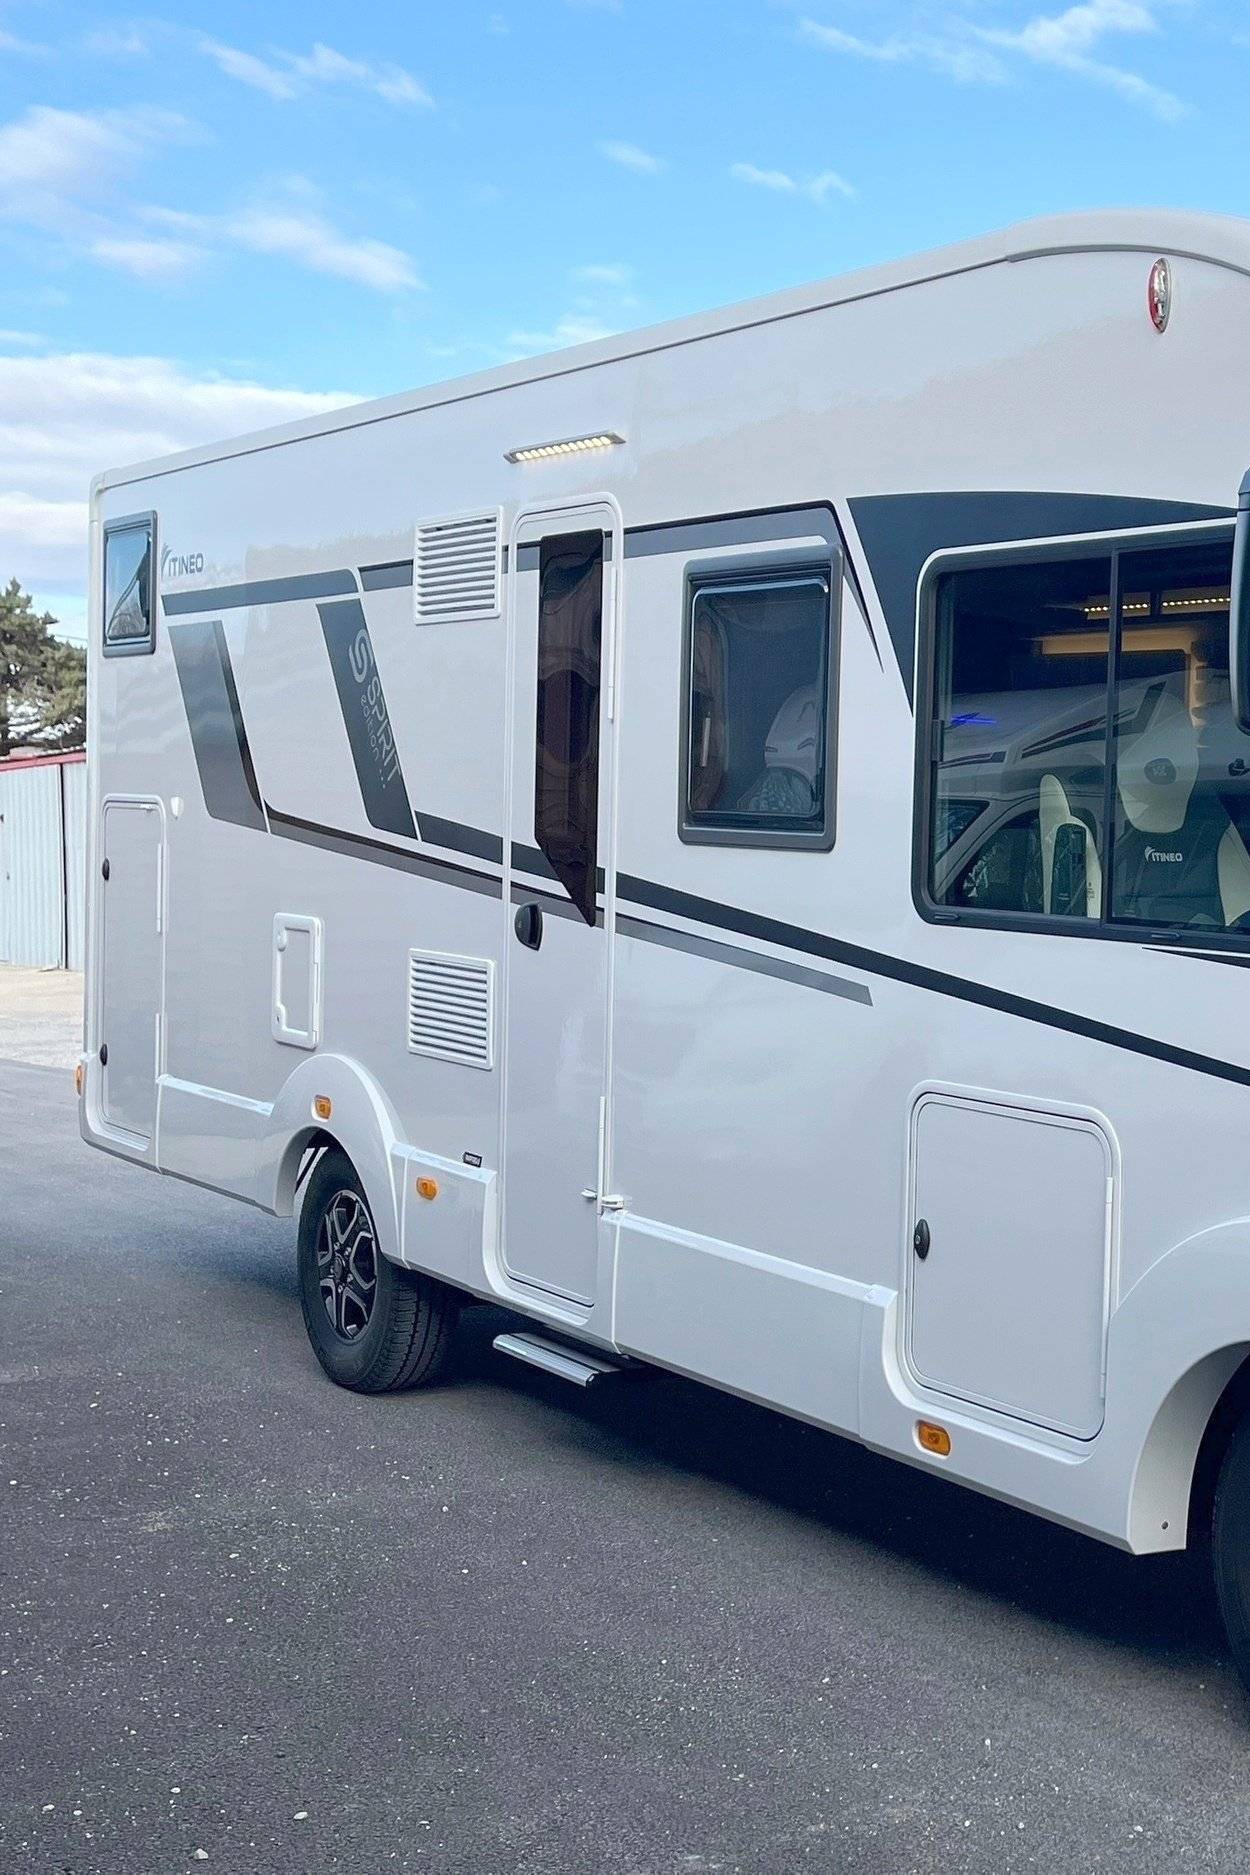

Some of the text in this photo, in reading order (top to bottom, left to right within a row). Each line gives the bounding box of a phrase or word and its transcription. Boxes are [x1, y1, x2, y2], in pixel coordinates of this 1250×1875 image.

[168, 552, 204, 577] ITINEO
[367, 675, 402, 781] SPIRIT
[1151, 851, 1184, 863] ITINEO
